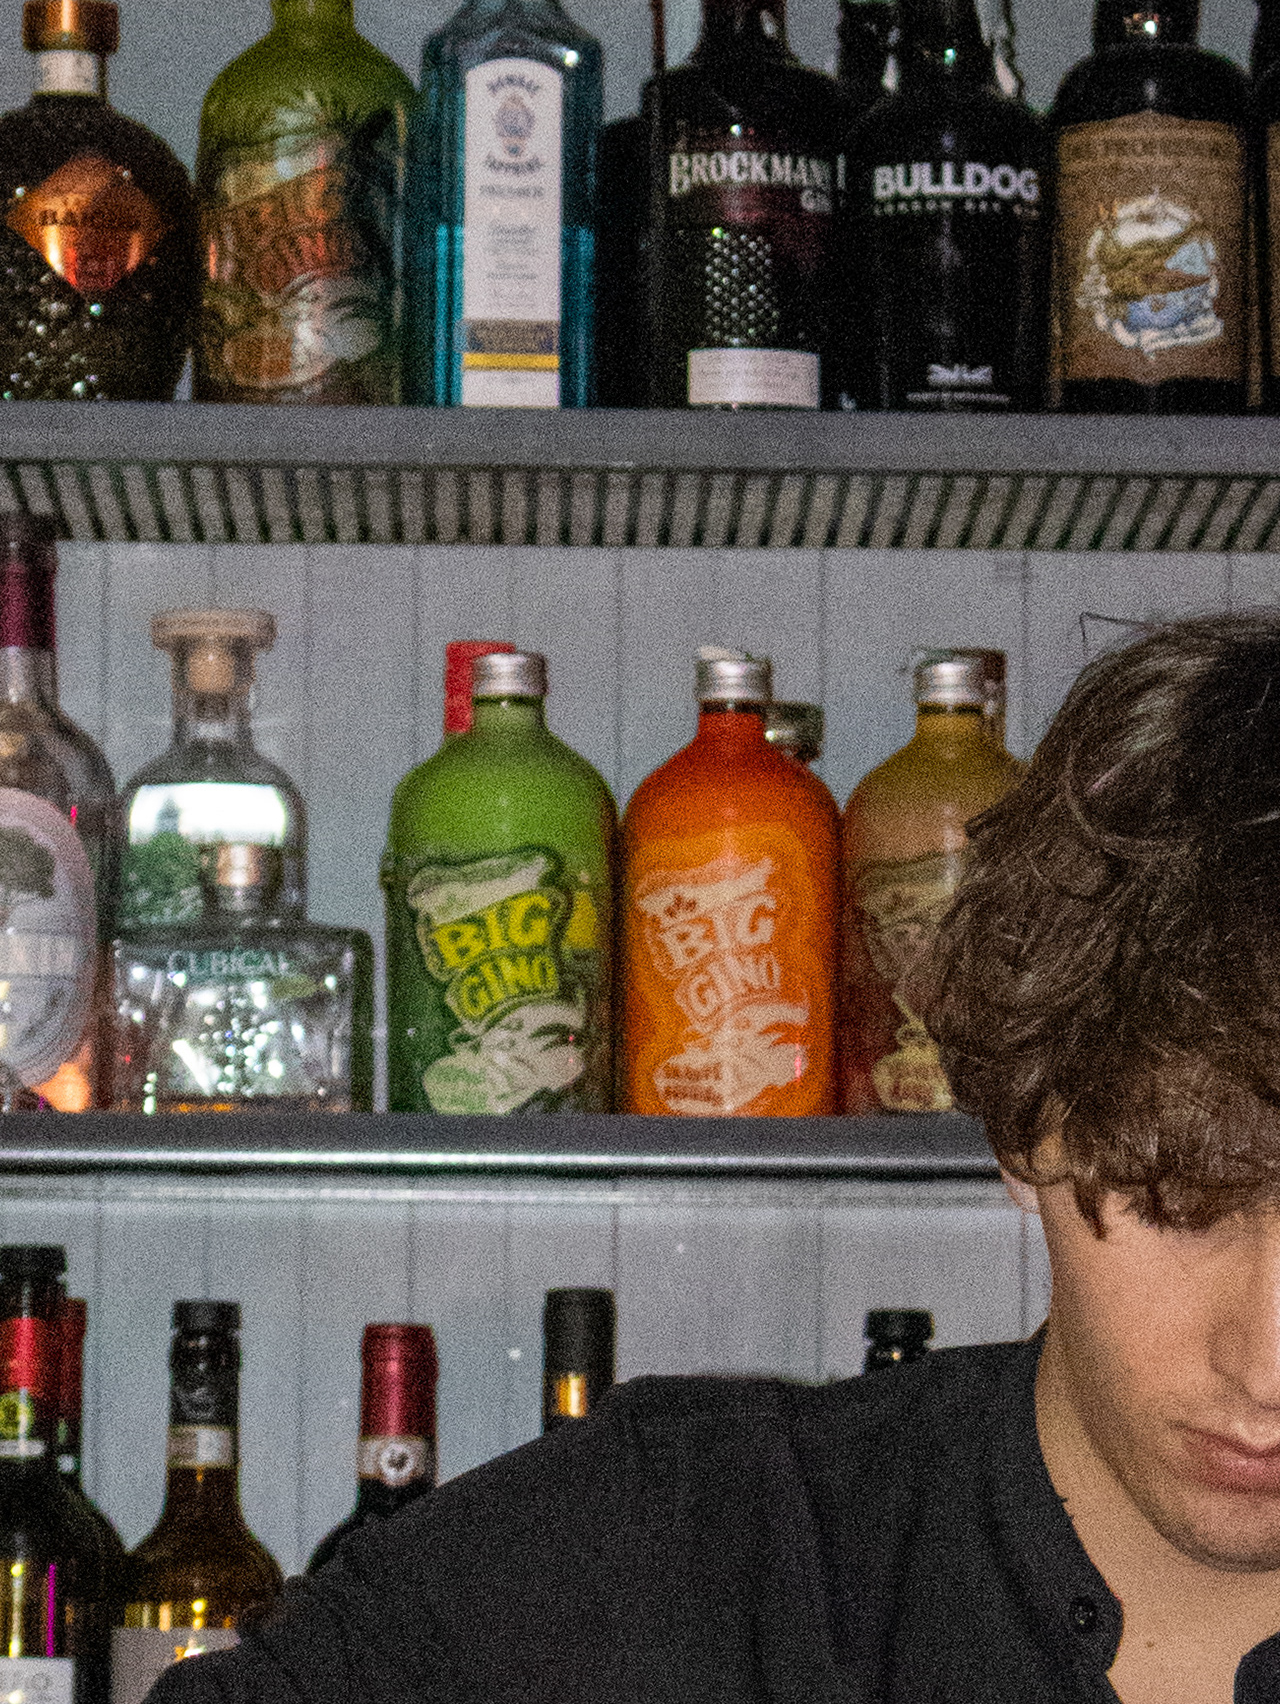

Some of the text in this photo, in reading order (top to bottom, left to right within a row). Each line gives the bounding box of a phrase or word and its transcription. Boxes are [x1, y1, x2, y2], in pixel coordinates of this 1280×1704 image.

[873, 161, 1040, 201] BULLDOG
[430, 892, 553, 970] BIG
[659, 894, 778, 970] BIG
[456, 953, 556, 1019] GINO
[688, 951, 781, 1019] GINO
